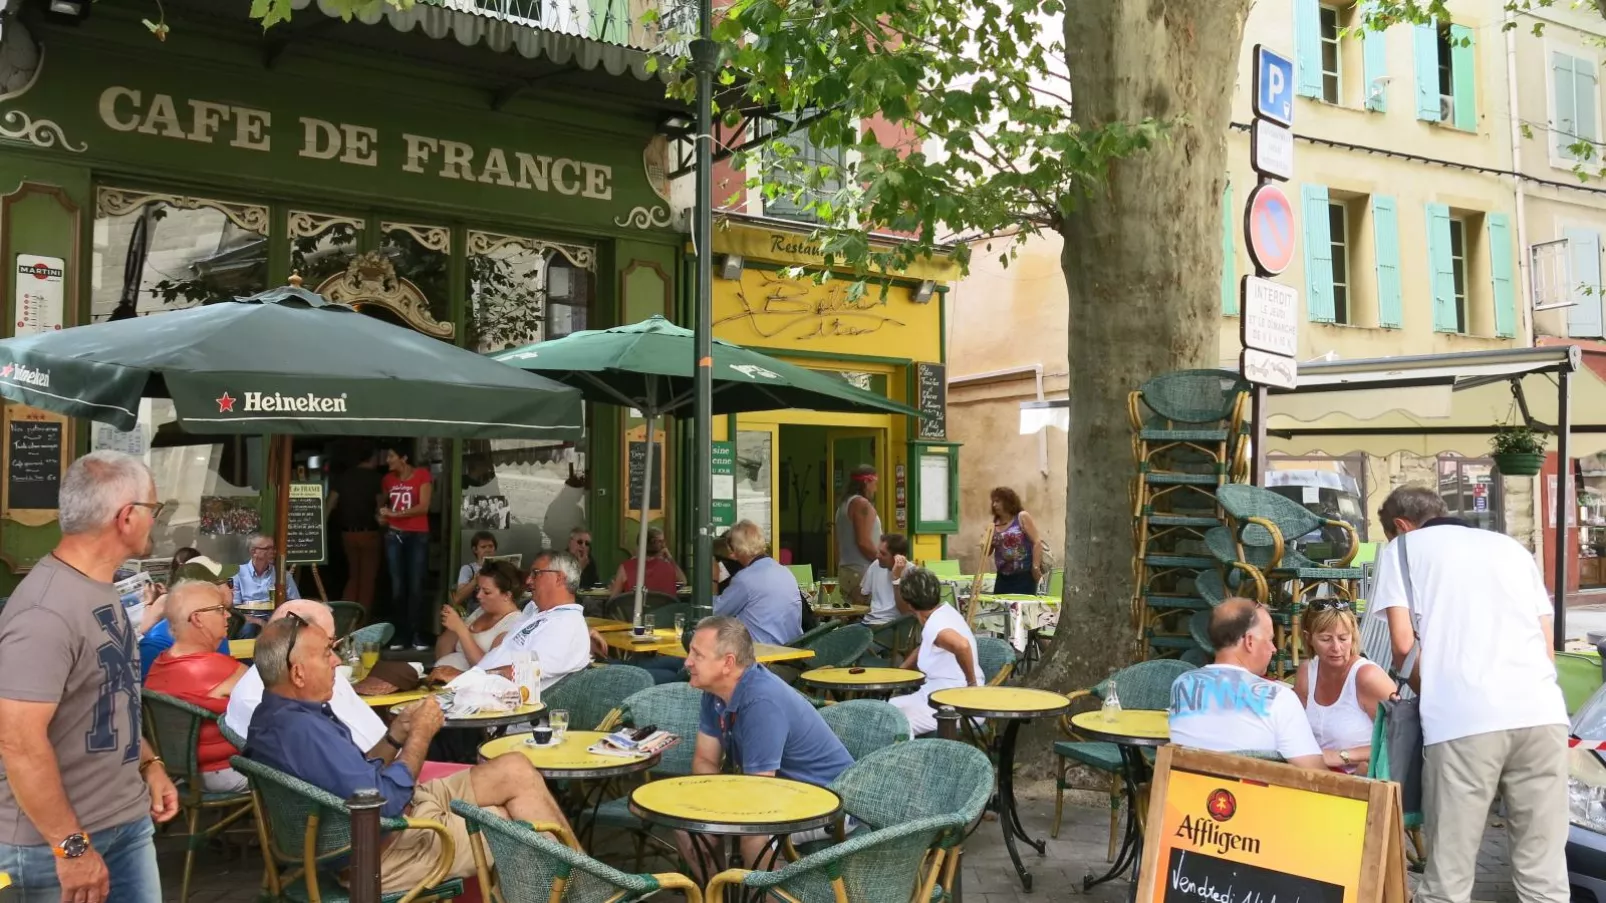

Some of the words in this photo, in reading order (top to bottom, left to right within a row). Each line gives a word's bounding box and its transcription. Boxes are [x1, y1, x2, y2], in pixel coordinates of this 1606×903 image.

[1268, 63, 1285, 105] P
[99, 86, 271, 152] CAFE
[299, 116, 378, 167] DE
[402, 133, 612, 201] FRANCE
[20, 266, 61, 277] MARTINI
[1254, 283, 1292, 307] INTERDIT
[244, 391, 347, 412] Heineken
[712, 445, 730, 455] sine
[389, 492, 412, 513] 79
[1174, 814, 1261, 855] Affligem
